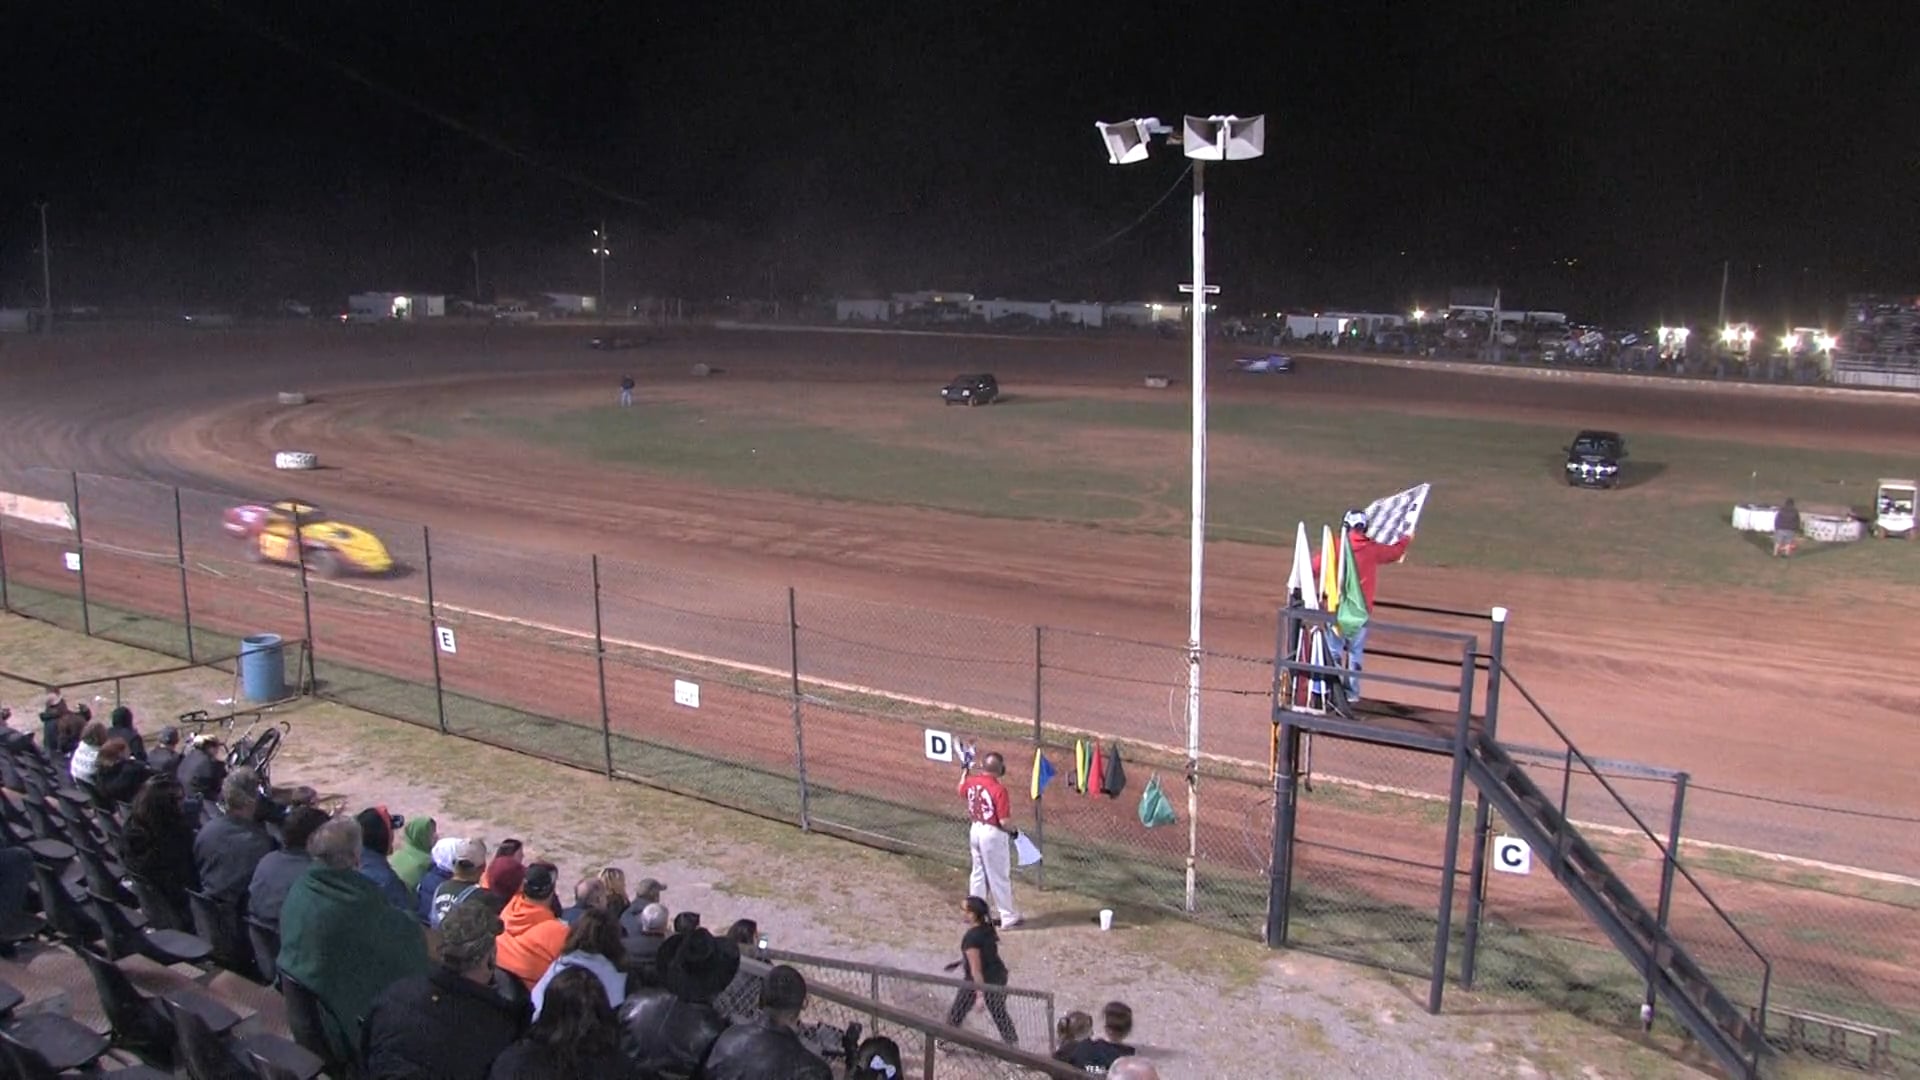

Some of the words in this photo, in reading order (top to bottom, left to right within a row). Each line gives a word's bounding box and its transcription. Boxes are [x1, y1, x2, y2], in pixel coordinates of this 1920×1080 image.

[442, 632, 452, 647] E
[931, 735, 947, 755] D
[1501, 844, 1522, 867] C
